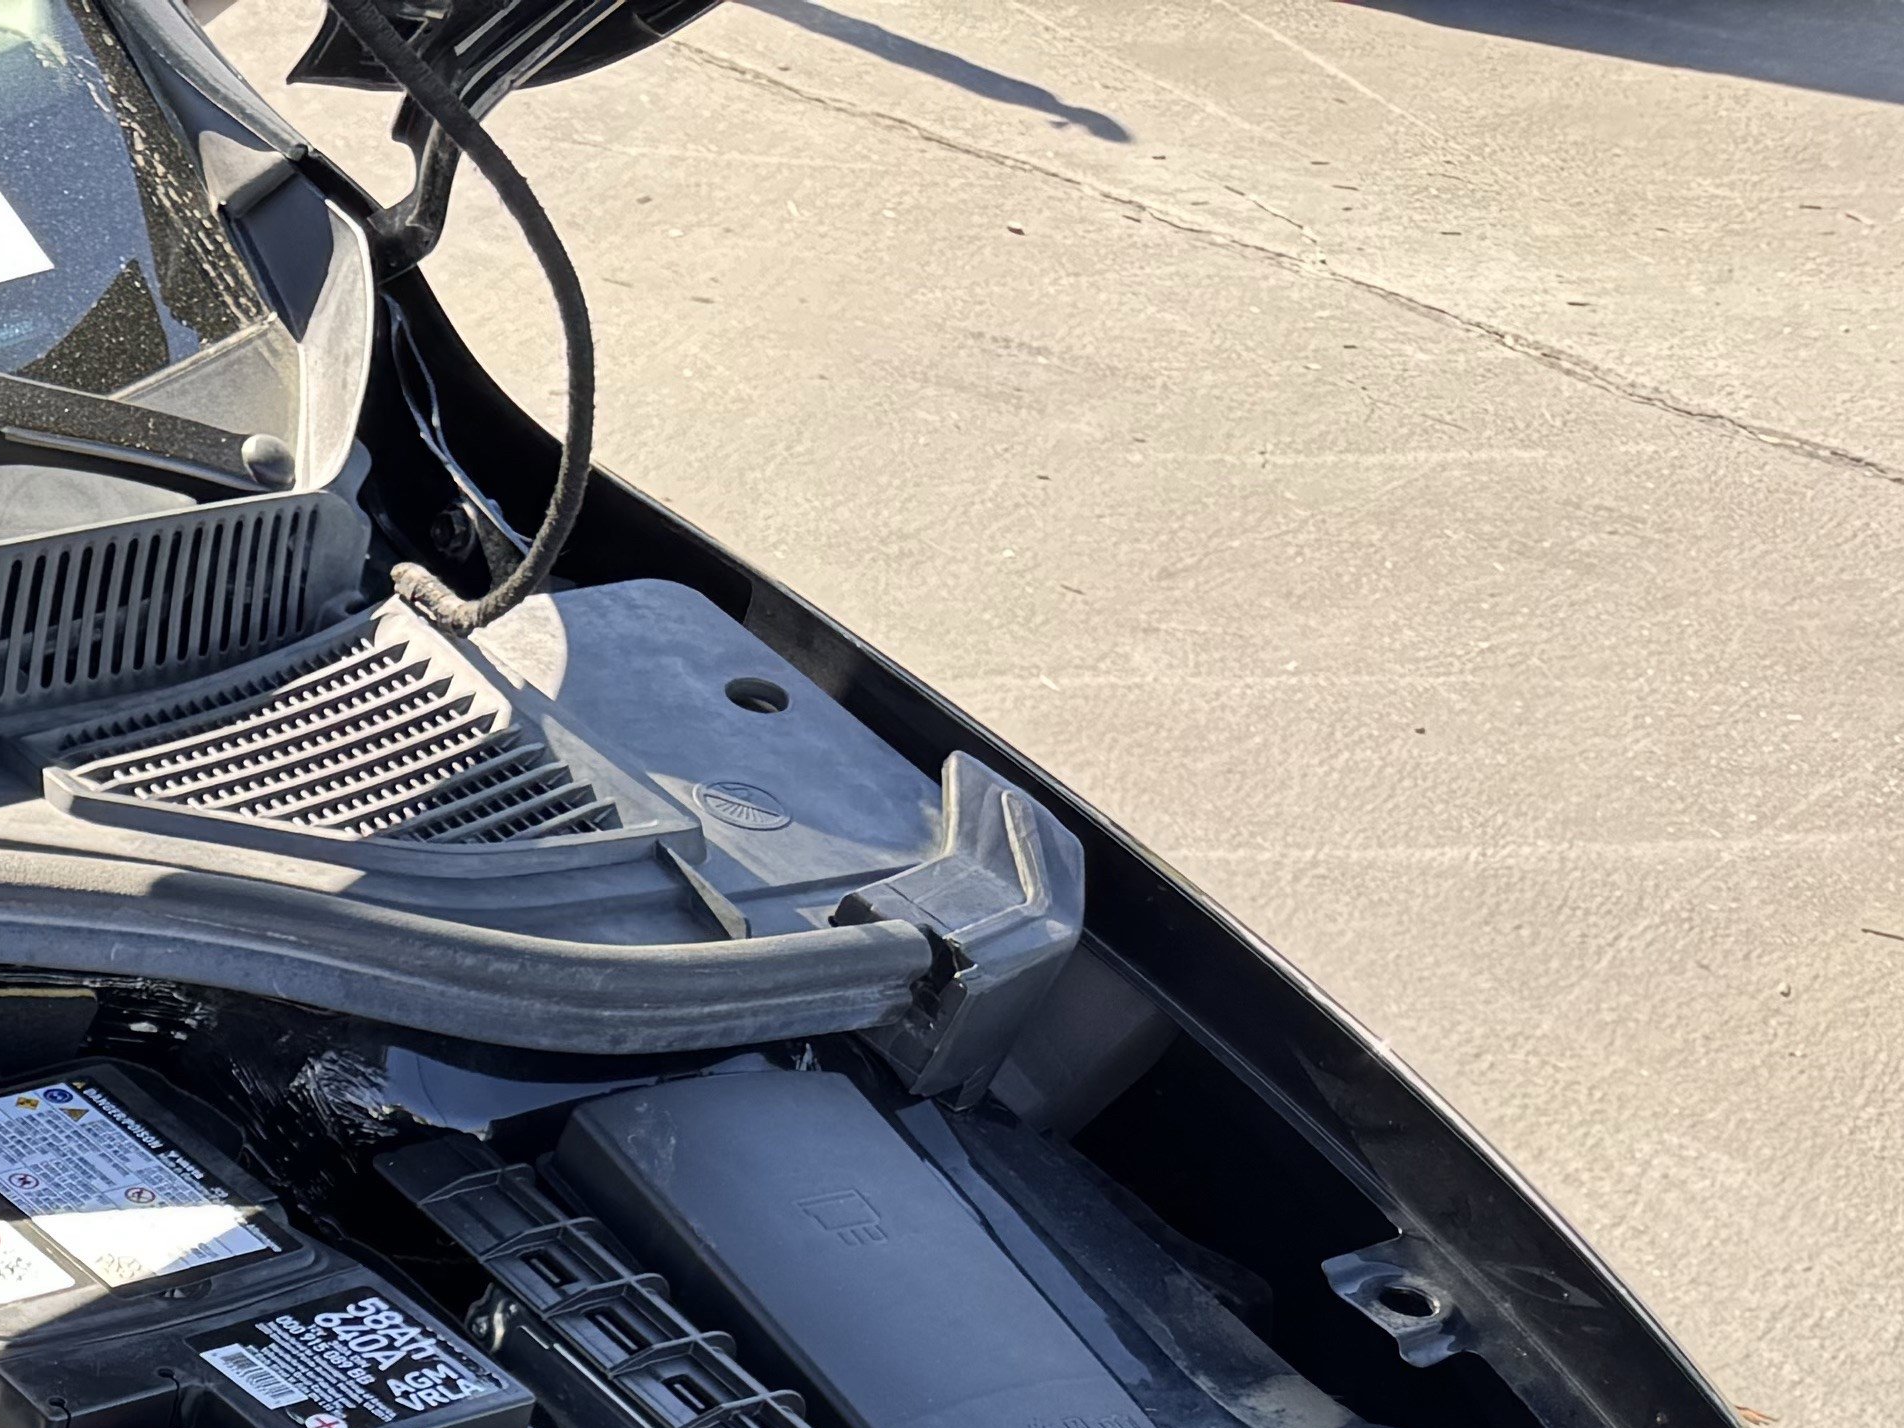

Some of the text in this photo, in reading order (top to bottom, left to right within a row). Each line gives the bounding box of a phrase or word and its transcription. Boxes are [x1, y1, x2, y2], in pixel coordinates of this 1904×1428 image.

[295, 1331, 333, 1352] 915
[307, 1306, 417, 1371] 640A
[340, 1295, 451, 1361] 58Ah
[375, 1363, 461, 1396] AGM
[391, 1376, 488, 1413] VRLA
